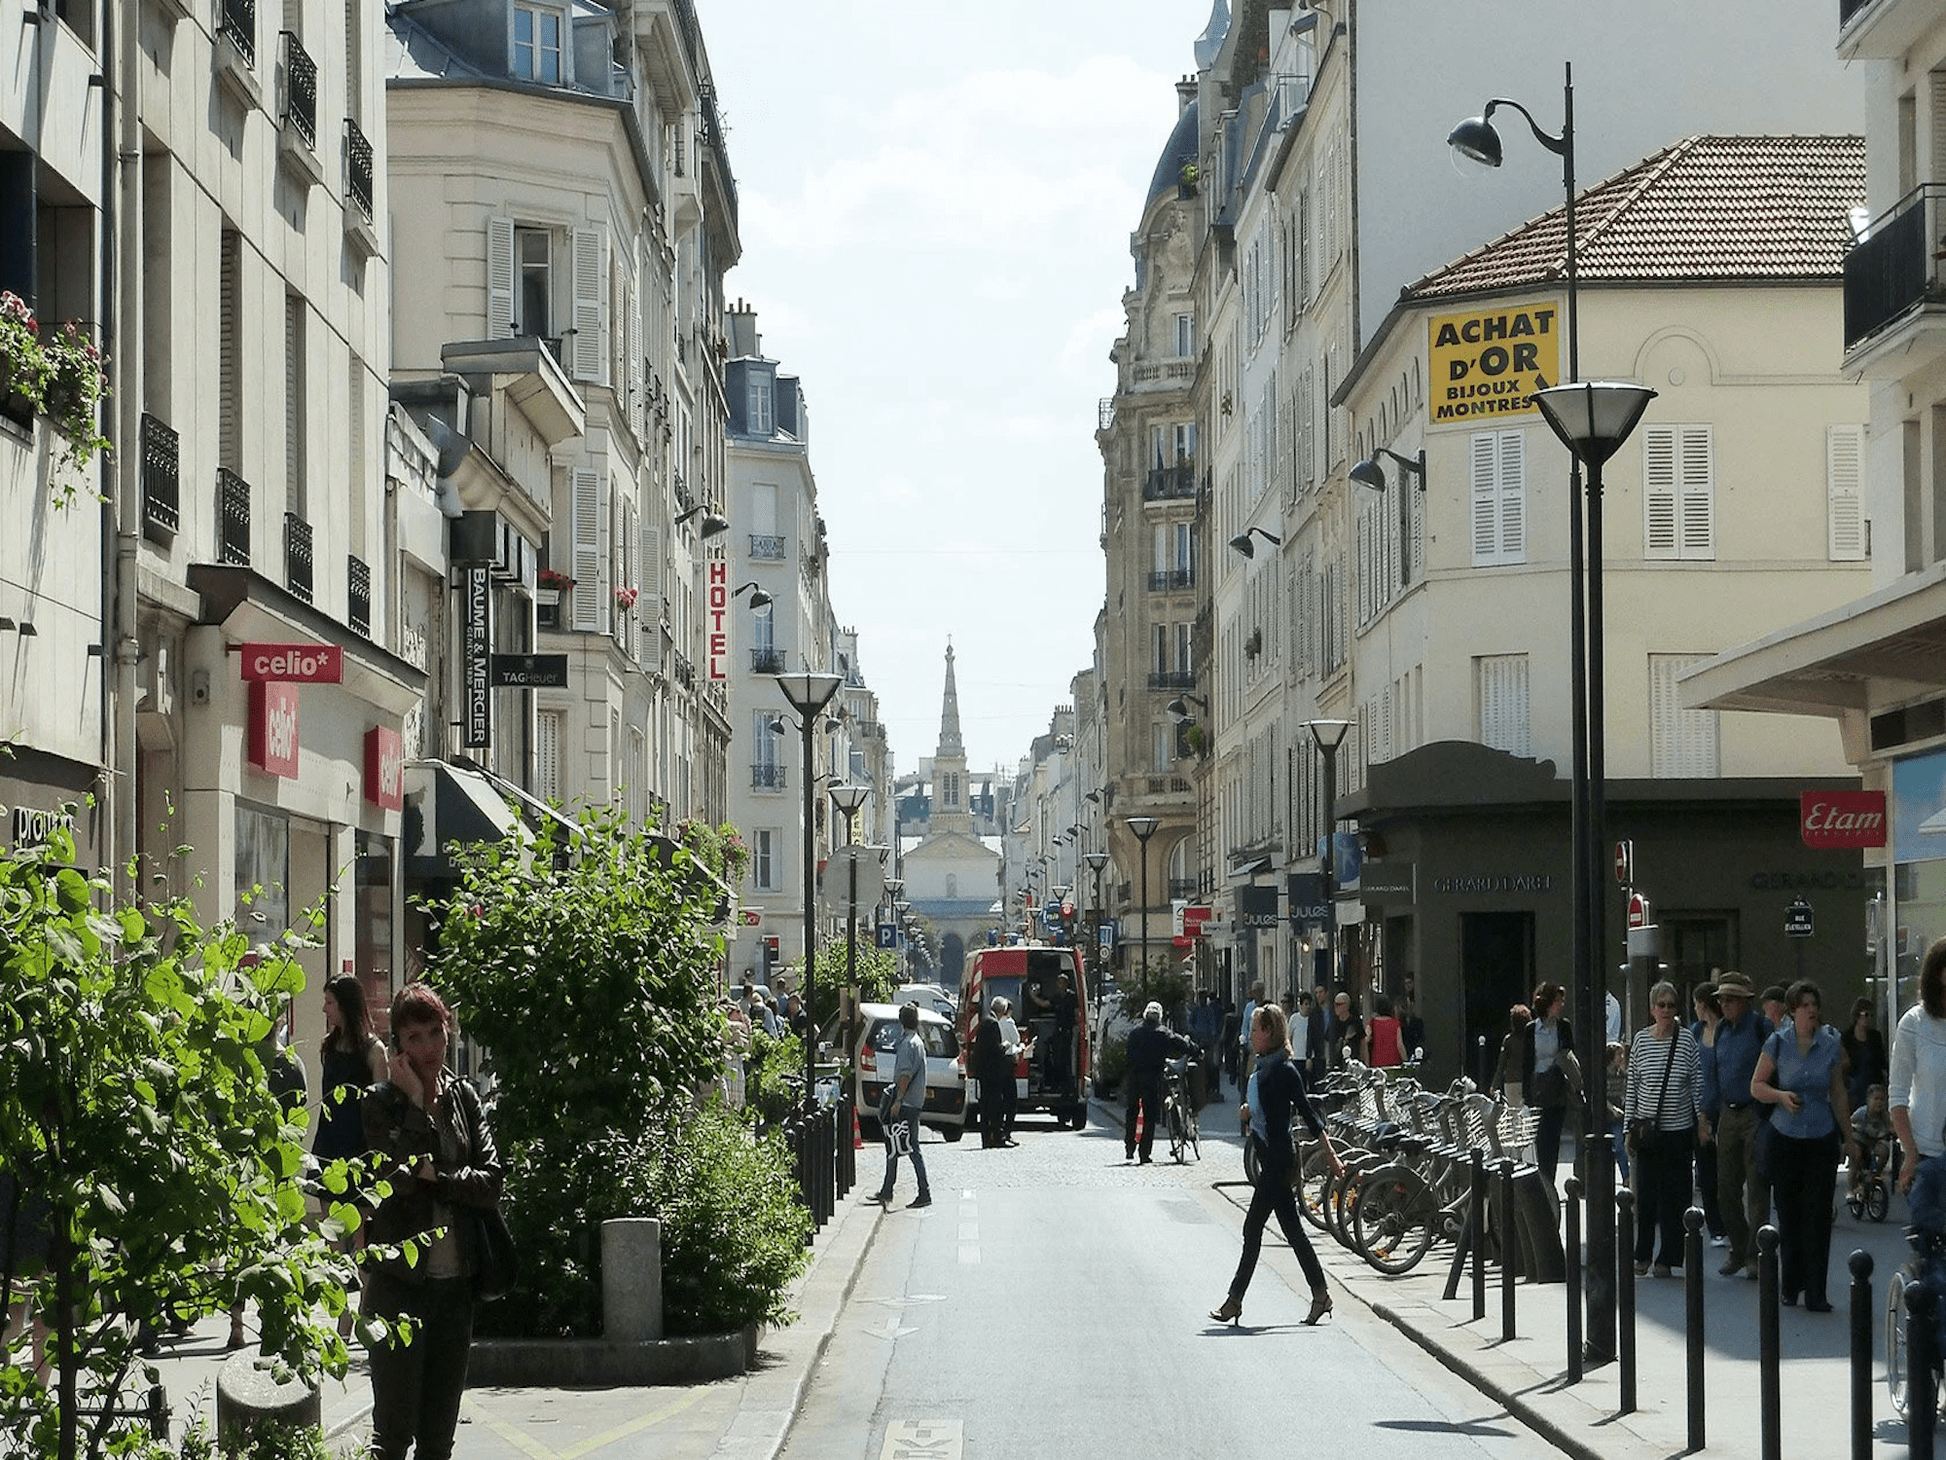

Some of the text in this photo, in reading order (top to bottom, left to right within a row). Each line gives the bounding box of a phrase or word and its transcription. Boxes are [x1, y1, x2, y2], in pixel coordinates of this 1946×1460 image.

[1435, 310, 1554, 348] ACHAT
[1450, 342, 1539, 381] D'OR
[1447, 379, 1520, 400] BIJOUX
[1436, 395, 1533, 418] MONTRES
[710, 563, 725, 679] HOTEL
[473, 567, 486, 742] BAUME & MERCIER
[1805, 802, 1883, 830] Etam
[881, 928, 892, 945] P
